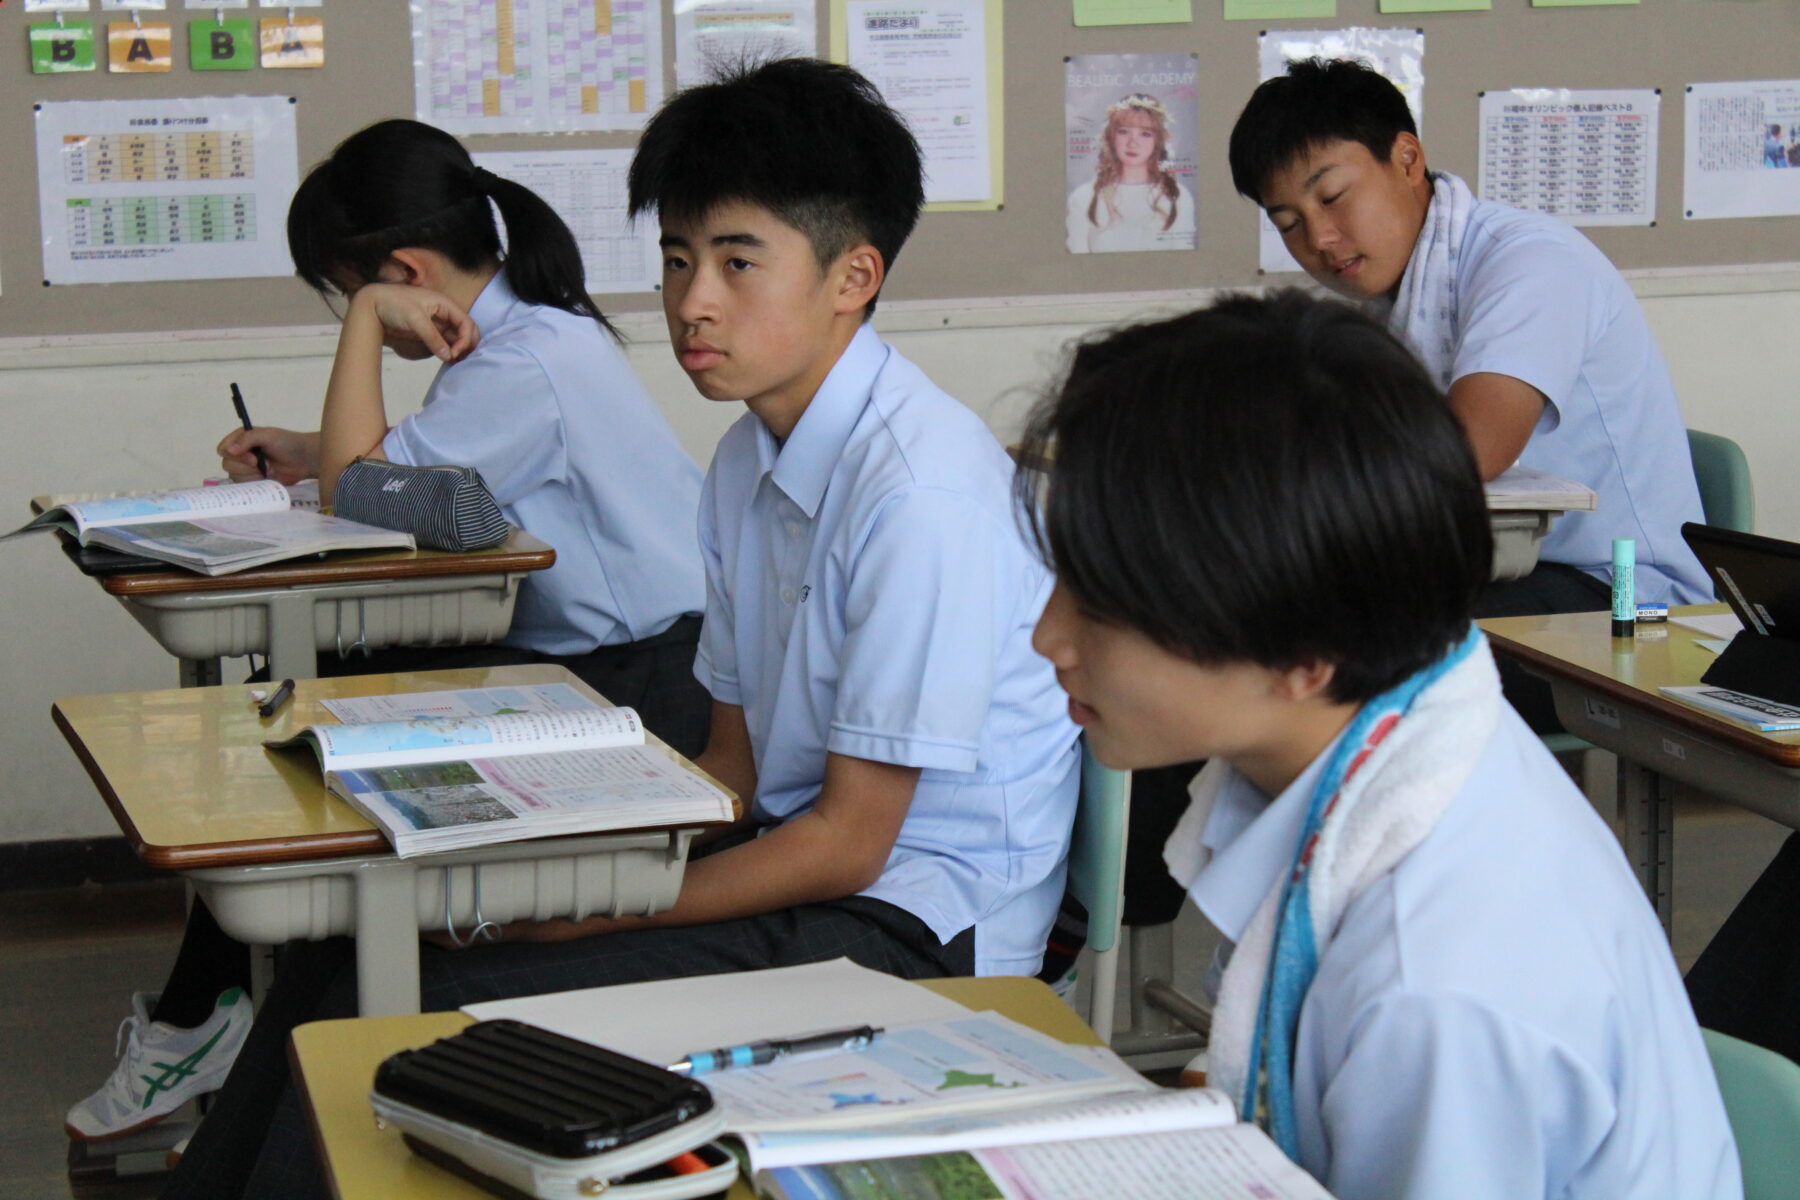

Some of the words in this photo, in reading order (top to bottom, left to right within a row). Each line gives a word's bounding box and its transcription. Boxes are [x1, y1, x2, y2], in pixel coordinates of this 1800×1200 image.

[866, 17, 919, 30] 進路だより
[51, 35, 76, 62] B
[127, 31, 154, 62] A
[210, 31, 236, 60] B
[278, 27, 306, 58] A
[1131, 72, 1196, 86] ACADEMY
[382, 478, 405, 492] Lee
